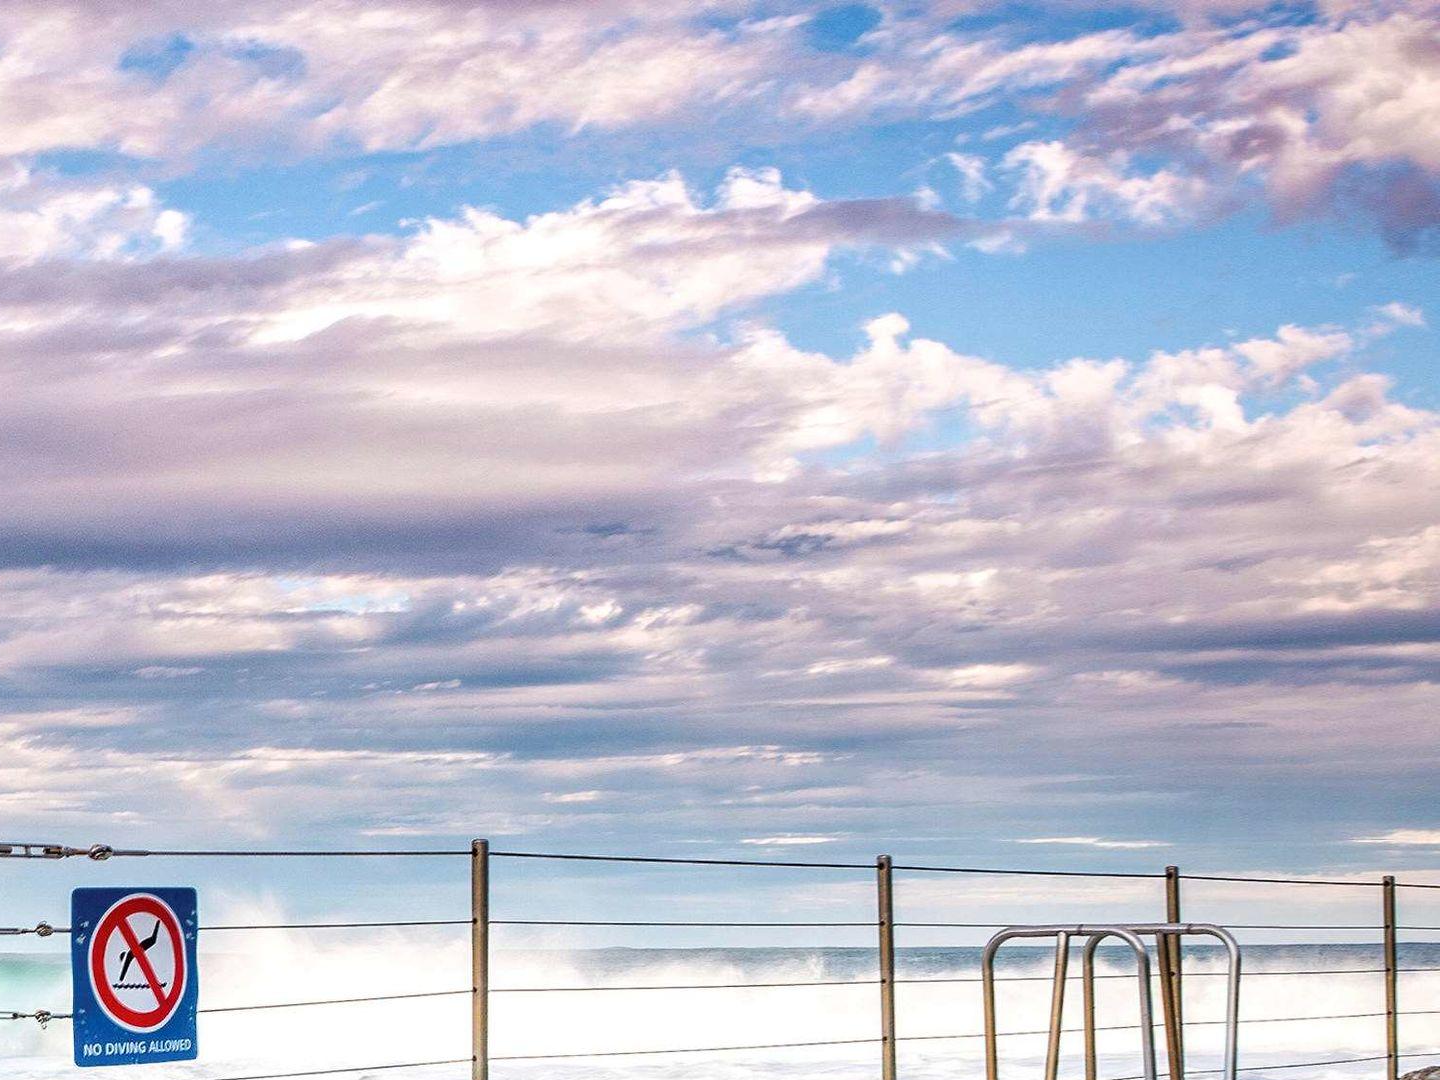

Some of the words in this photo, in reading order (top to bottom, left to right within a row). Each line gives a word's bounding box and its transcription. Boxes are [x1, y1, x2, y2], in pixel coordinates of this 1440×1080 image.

[83, 1043, 102, 1056] NO
[105, 1041, 146, 1056] DIVING
[148, 1038, 191, 1053] ALLOWED
